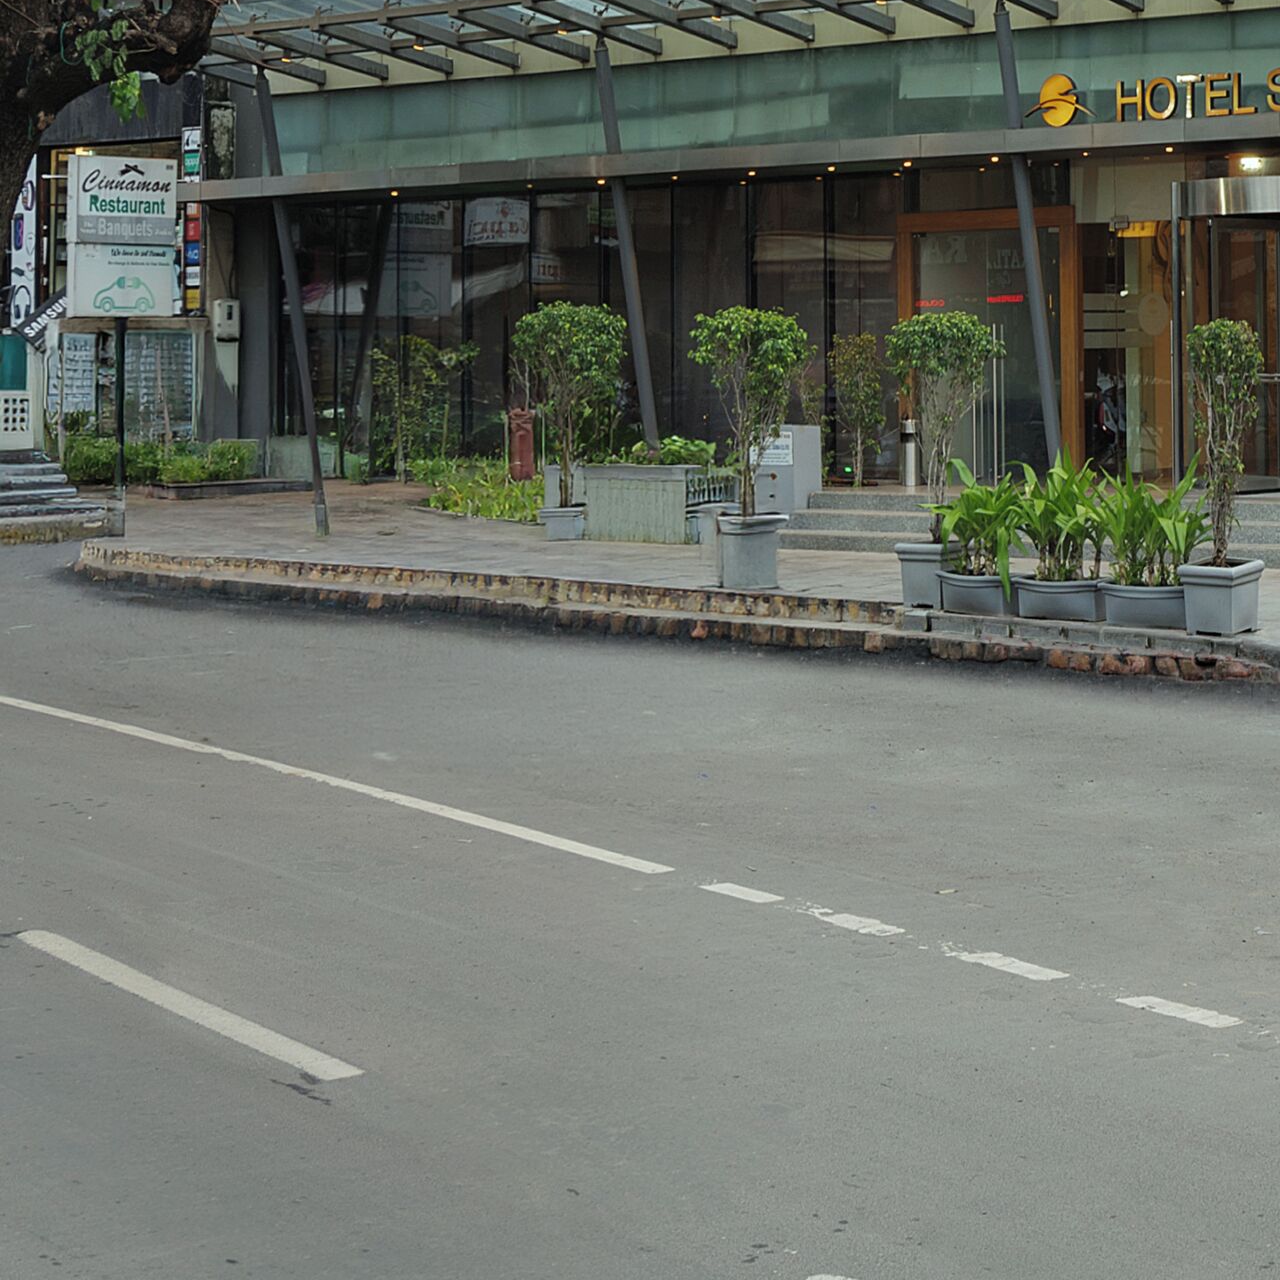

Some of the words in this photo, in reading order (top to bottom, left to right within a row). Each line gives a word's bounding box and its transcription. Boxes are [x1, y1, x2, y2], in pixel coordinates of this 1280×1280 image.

[1115, 72, 1258, 123] HOTEL
[82, 168, 171, 193] Cinnamon
[89, 194, 165, 215] Restaurant
[98, 217, 153, 240] Banquets
[23, 296, 68, 337] SAMSUN
